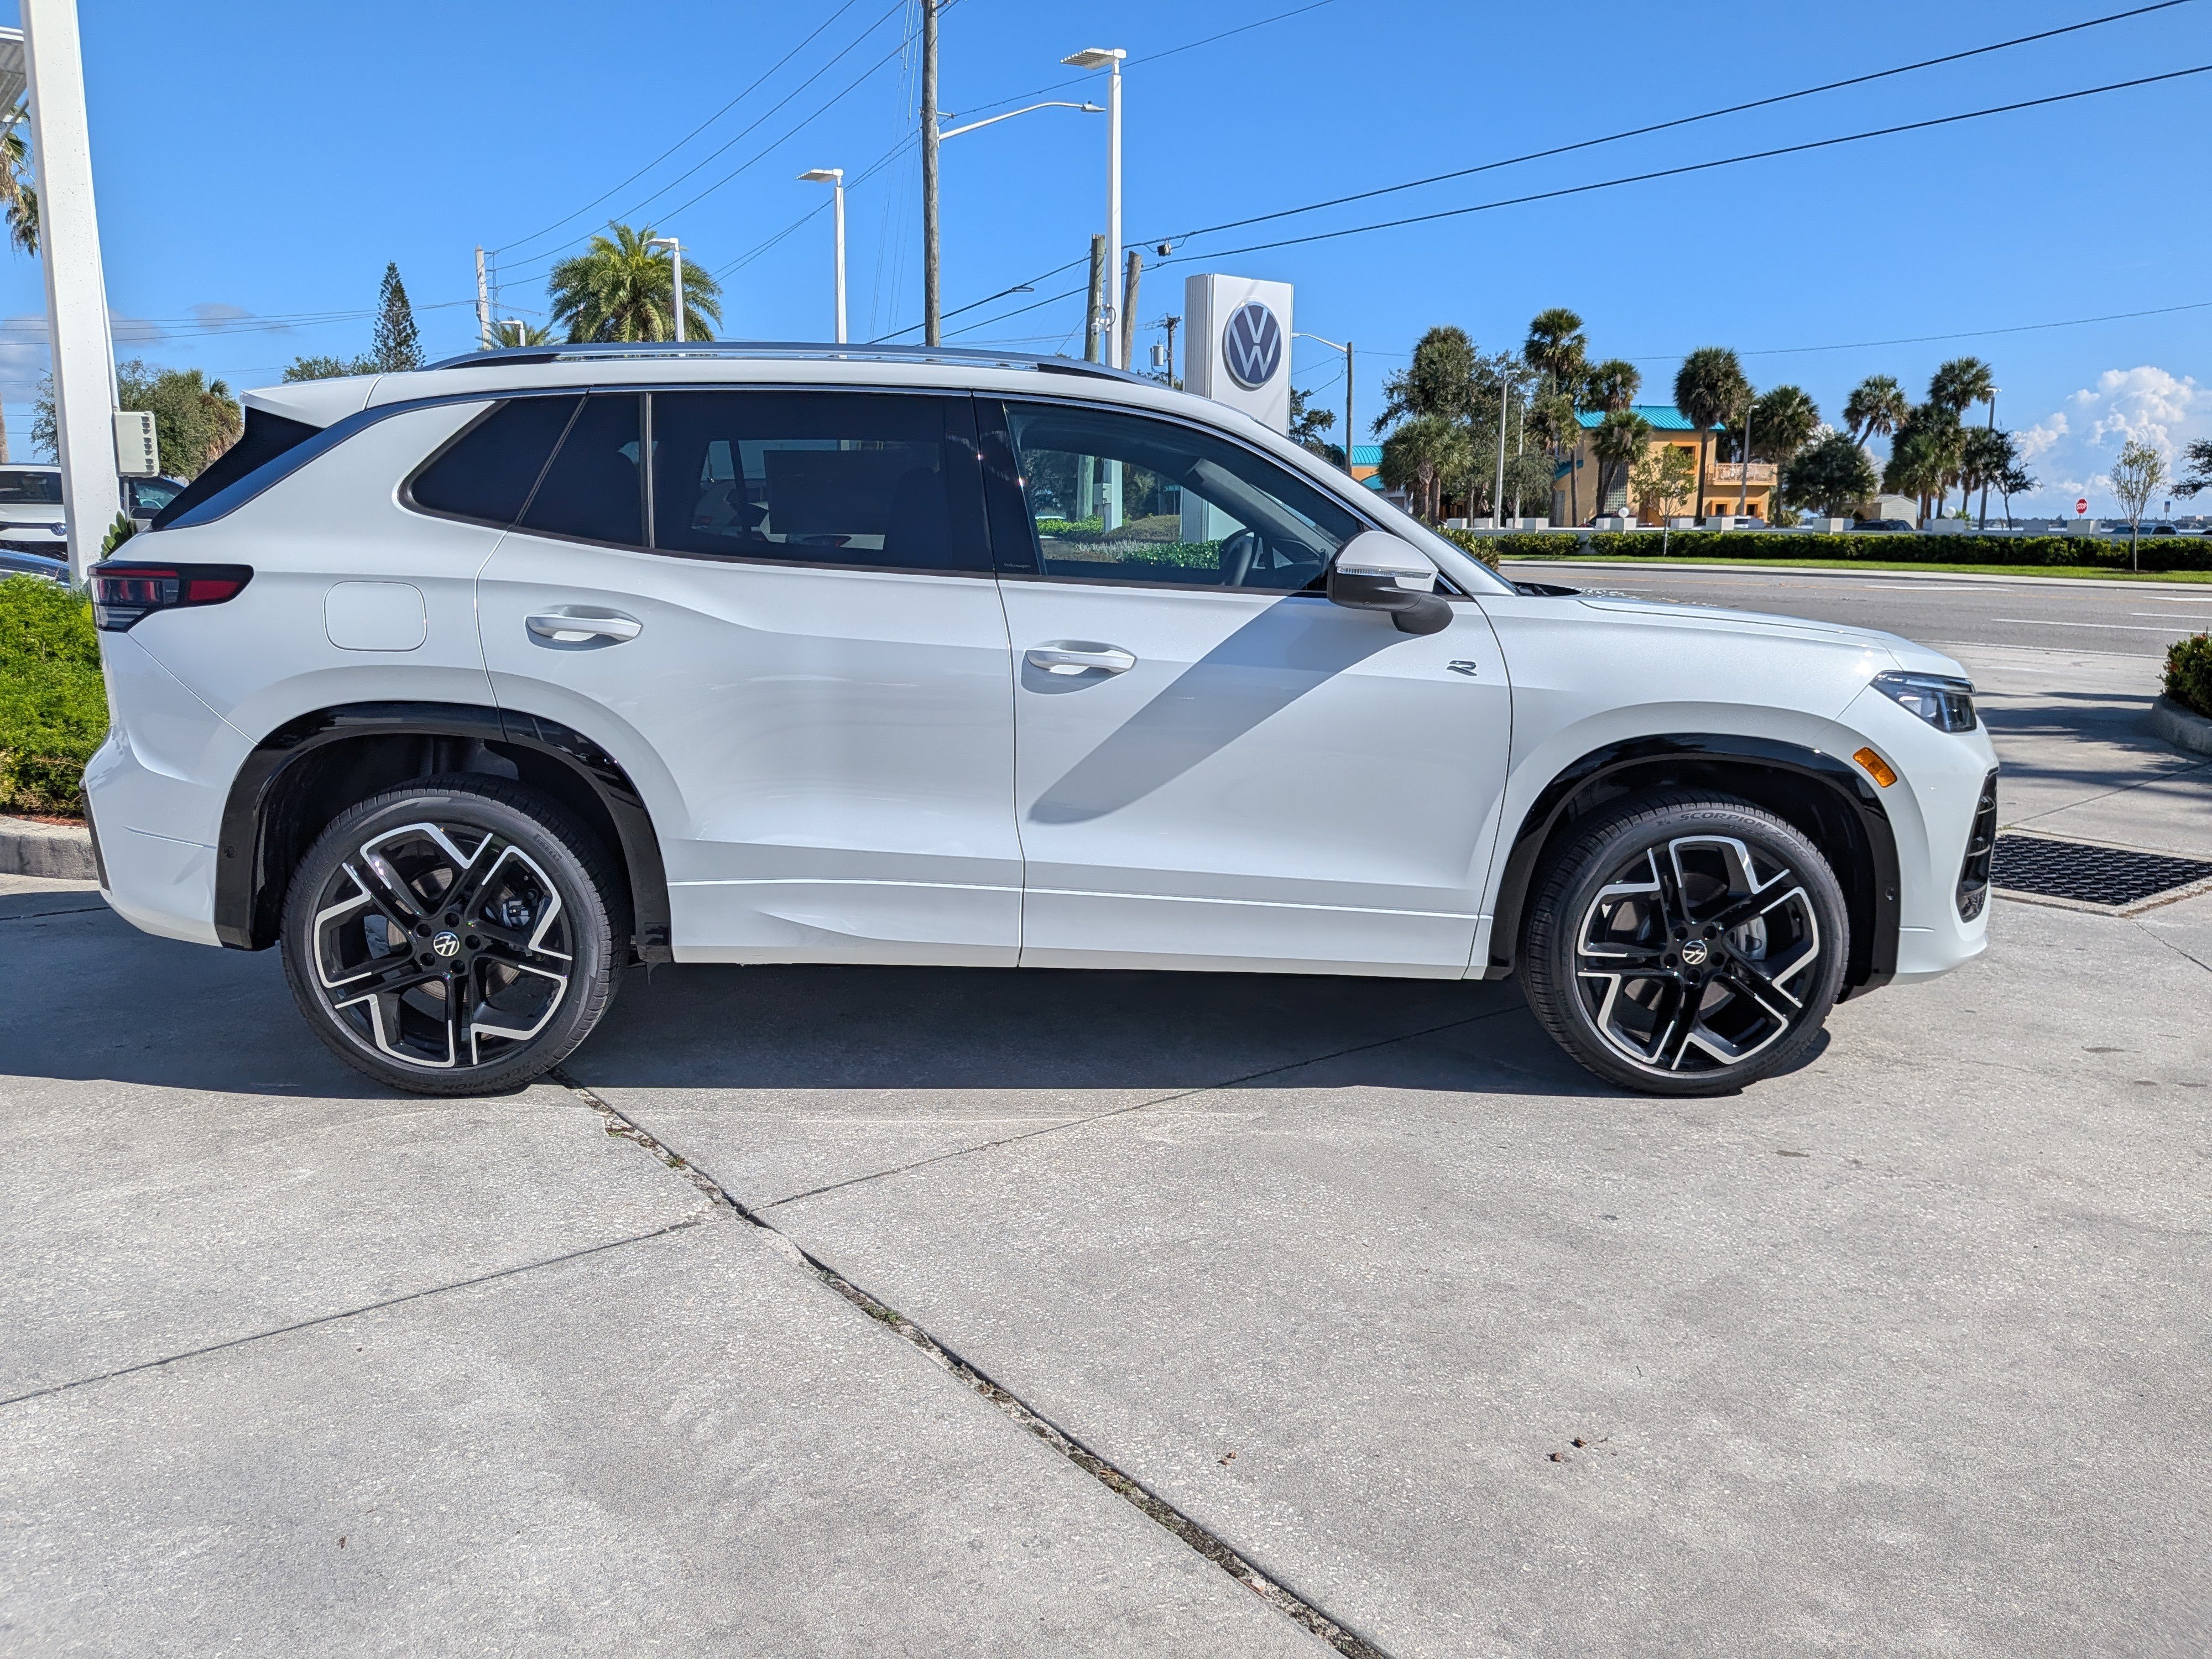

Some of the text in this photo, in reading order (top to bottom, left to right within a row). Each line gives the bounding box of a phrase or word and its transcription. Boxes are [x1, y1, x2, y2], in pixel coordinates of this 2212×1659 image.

[1229, 306, 1280, 380] VW
[1446, 660, 1478, 677] R
[1679, 812, 1767, 830] SCORPION
[1770, 829, 1811, 859] ZERO
